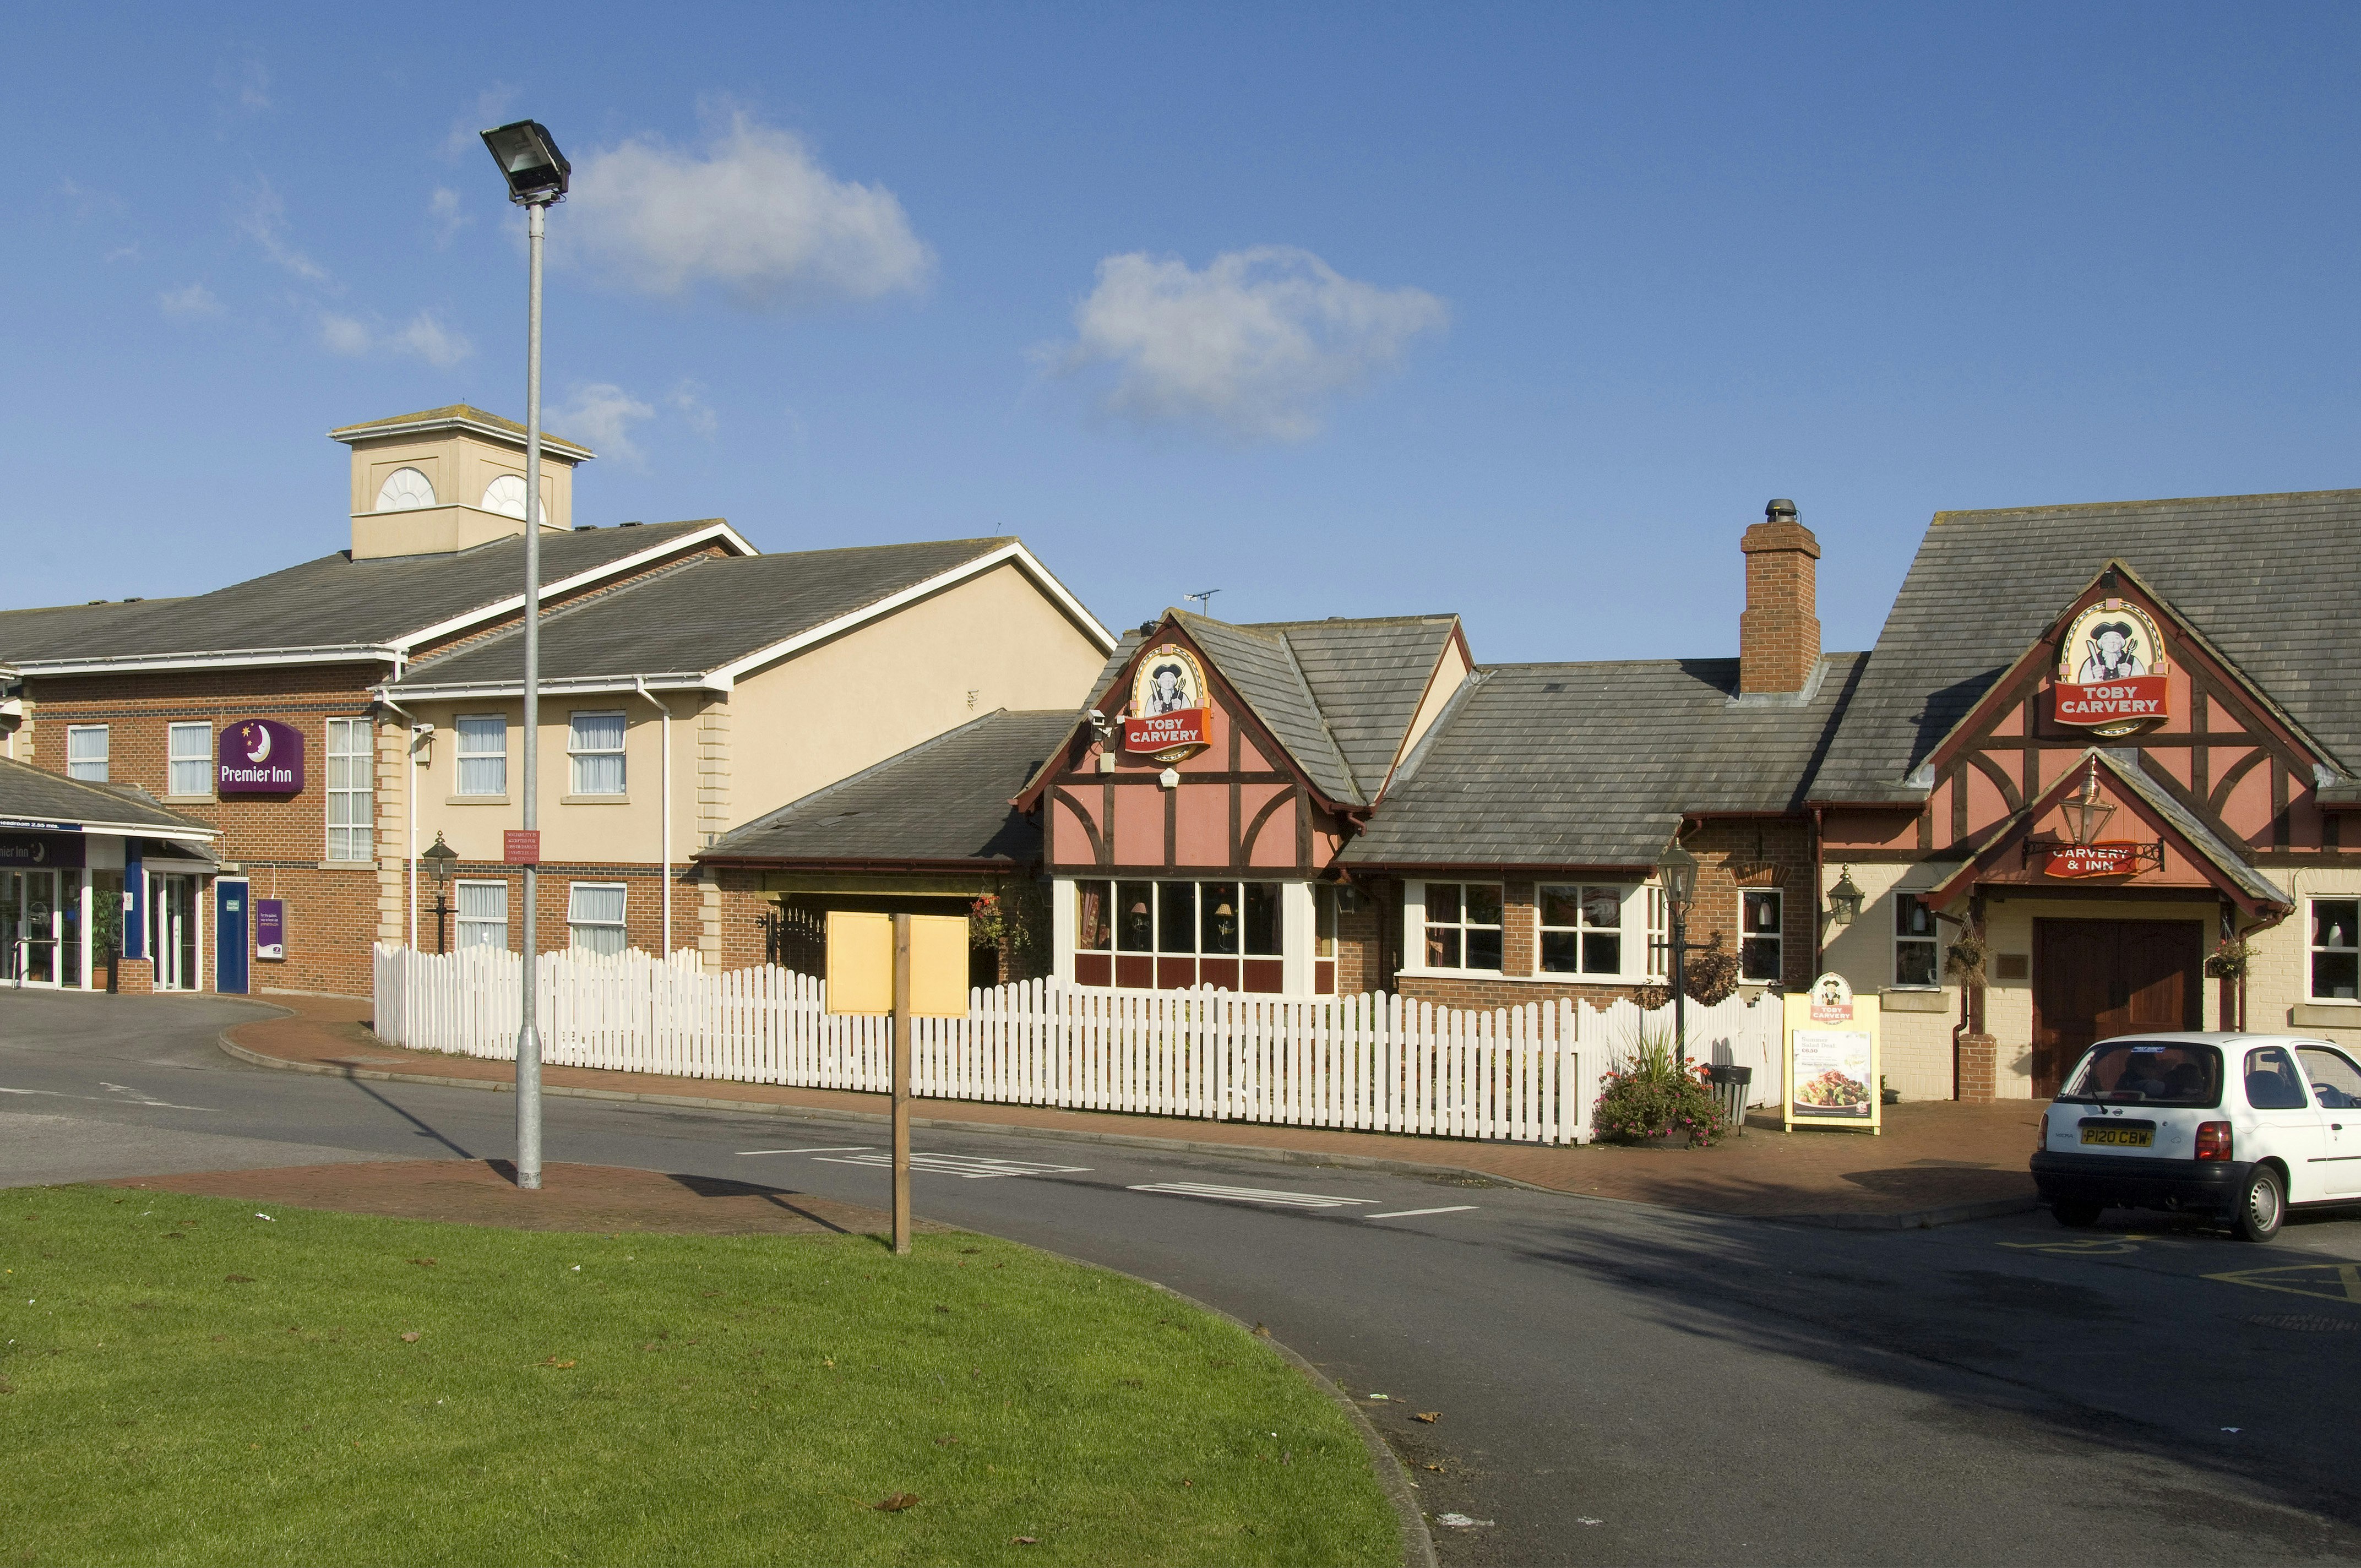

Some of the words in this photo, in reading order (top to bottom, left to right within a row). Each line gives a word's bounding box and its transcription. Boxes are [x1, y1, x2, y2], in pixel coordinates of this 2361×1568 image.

[2083, 686, 2138, 699] TOBY
[2061, 700, 2159, 714] CARVERY
[1145, 718, 1184, 731] TOBY
[1130, 729, 1198, 743] CARVERY
[221, 765, 271, 782] Premier
[272, 766, 292, 782] Inn
[16, 846, 29, 857] Inn
[2053, 848, 2129, 859] CARVERY
[2067, 860, 2079, 870] &
[2086, 861, 2114, 870] INN
[2086, 1130, 2115, 1142] P120
[2120, 1131, 2147, 1145] CBW
